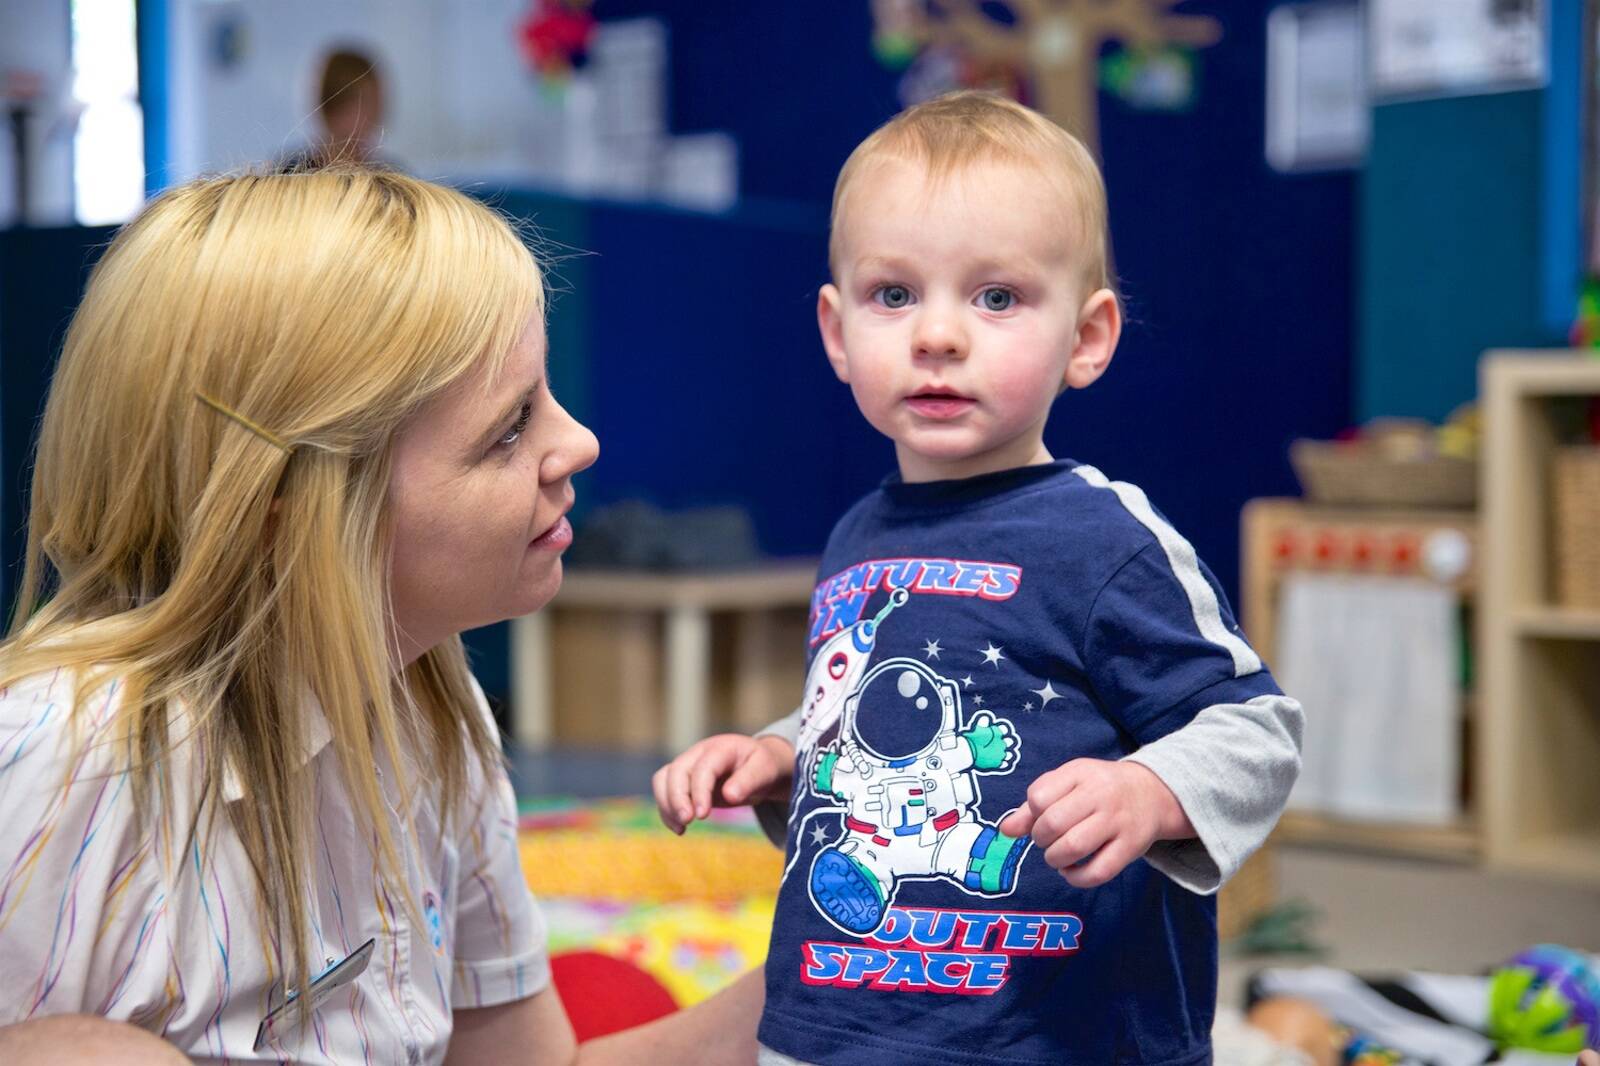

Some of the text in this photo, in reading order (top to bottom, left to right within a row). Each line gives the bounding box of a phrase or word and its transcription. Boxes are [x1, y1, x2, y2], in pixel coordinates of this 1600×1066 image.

[809, 591, 869, 647] IN
[867, 907, 1083, 955] OUTER
[801, 941, 1011, 995] SPACE
